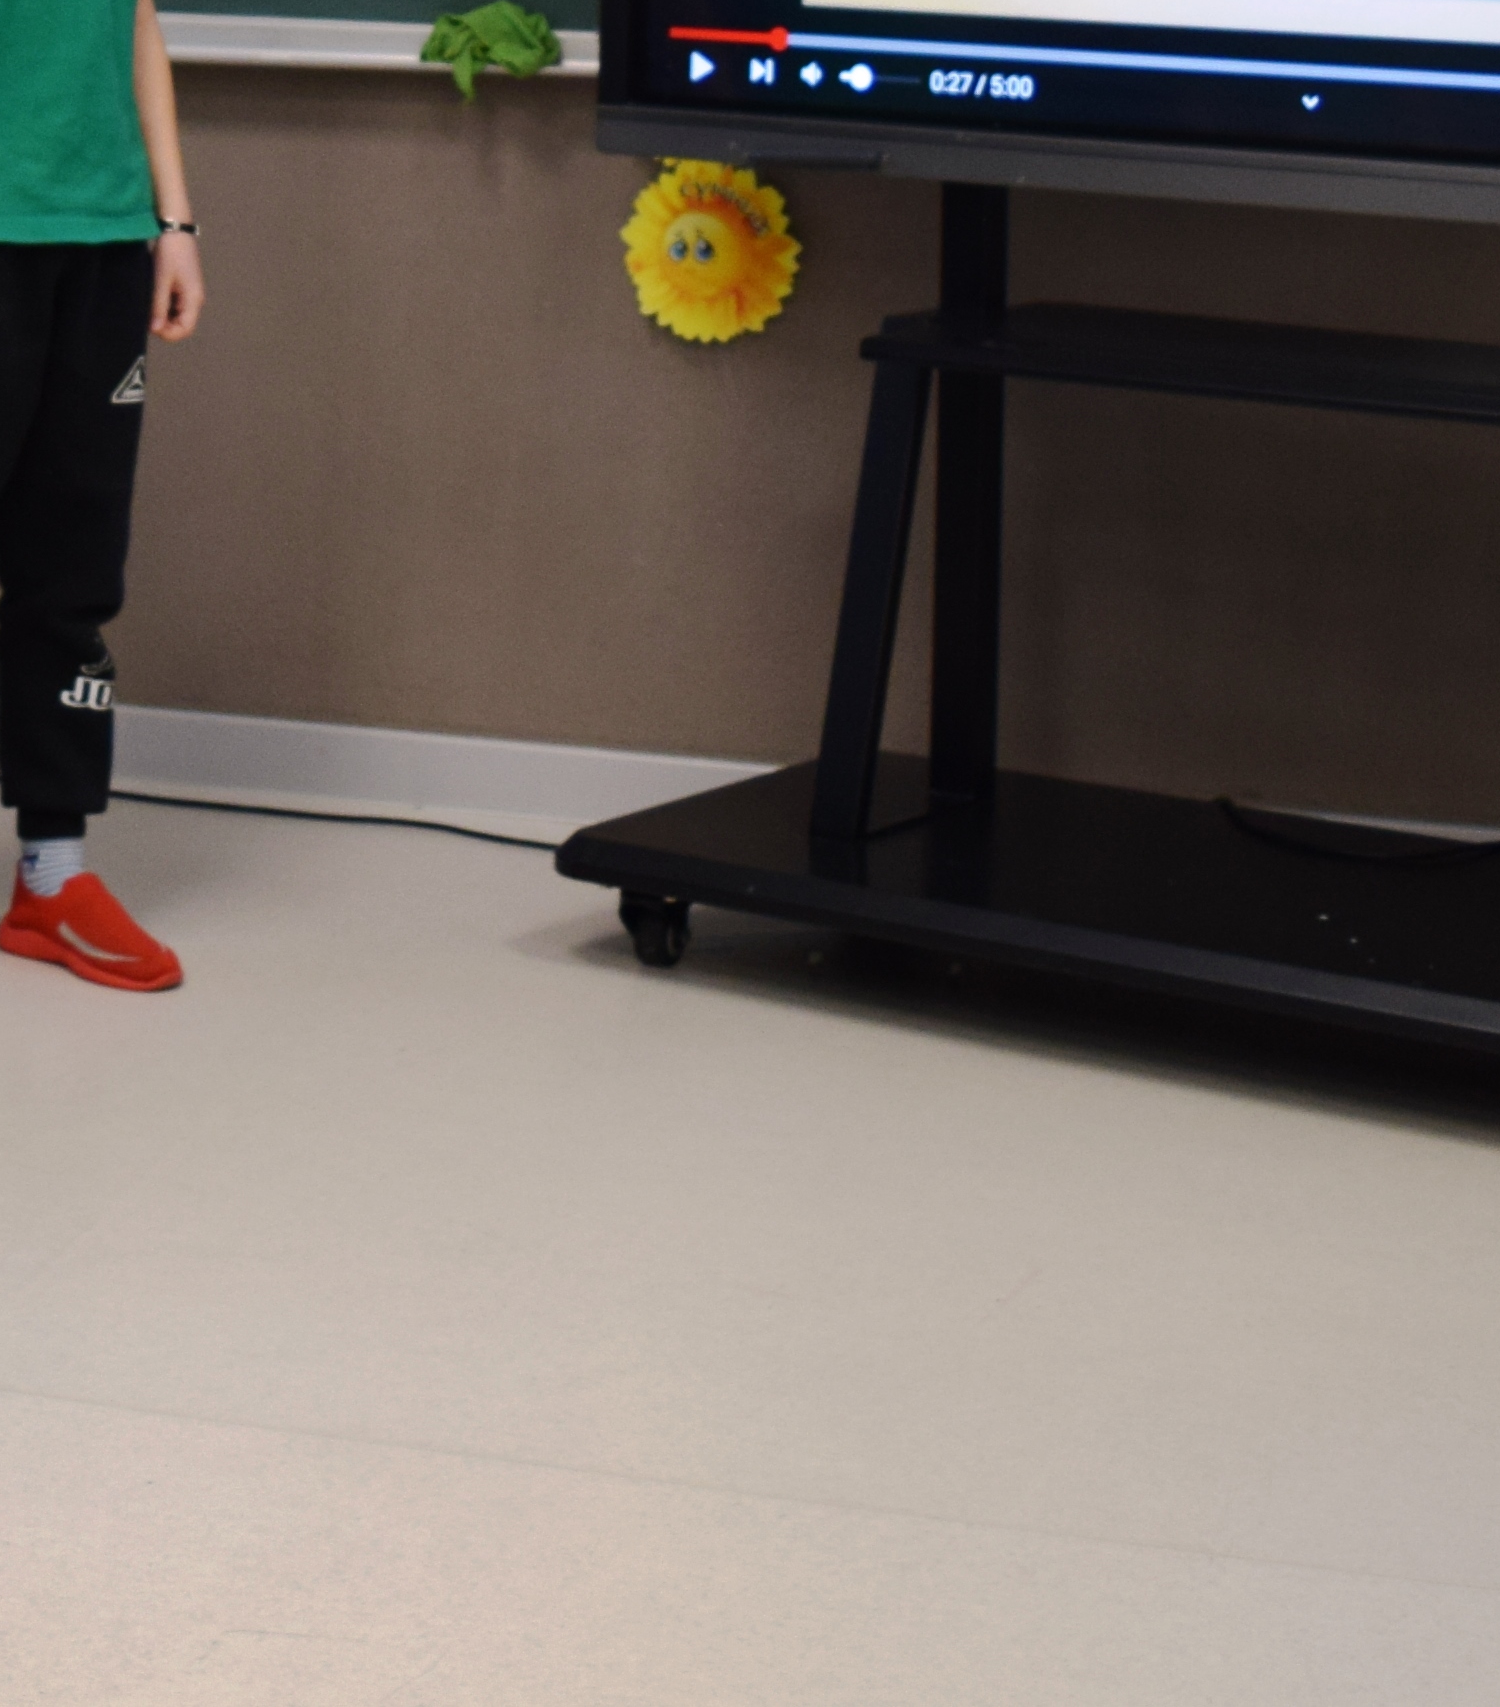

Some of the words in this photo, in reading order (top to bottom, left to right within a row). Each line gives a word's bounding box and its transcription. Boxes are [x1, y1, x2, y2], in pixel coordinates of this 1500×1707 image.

[929, 69, 974, 94] 0:27
[974, 72, 987, 98] /
[990, 73, 1034, 100] 5:00
